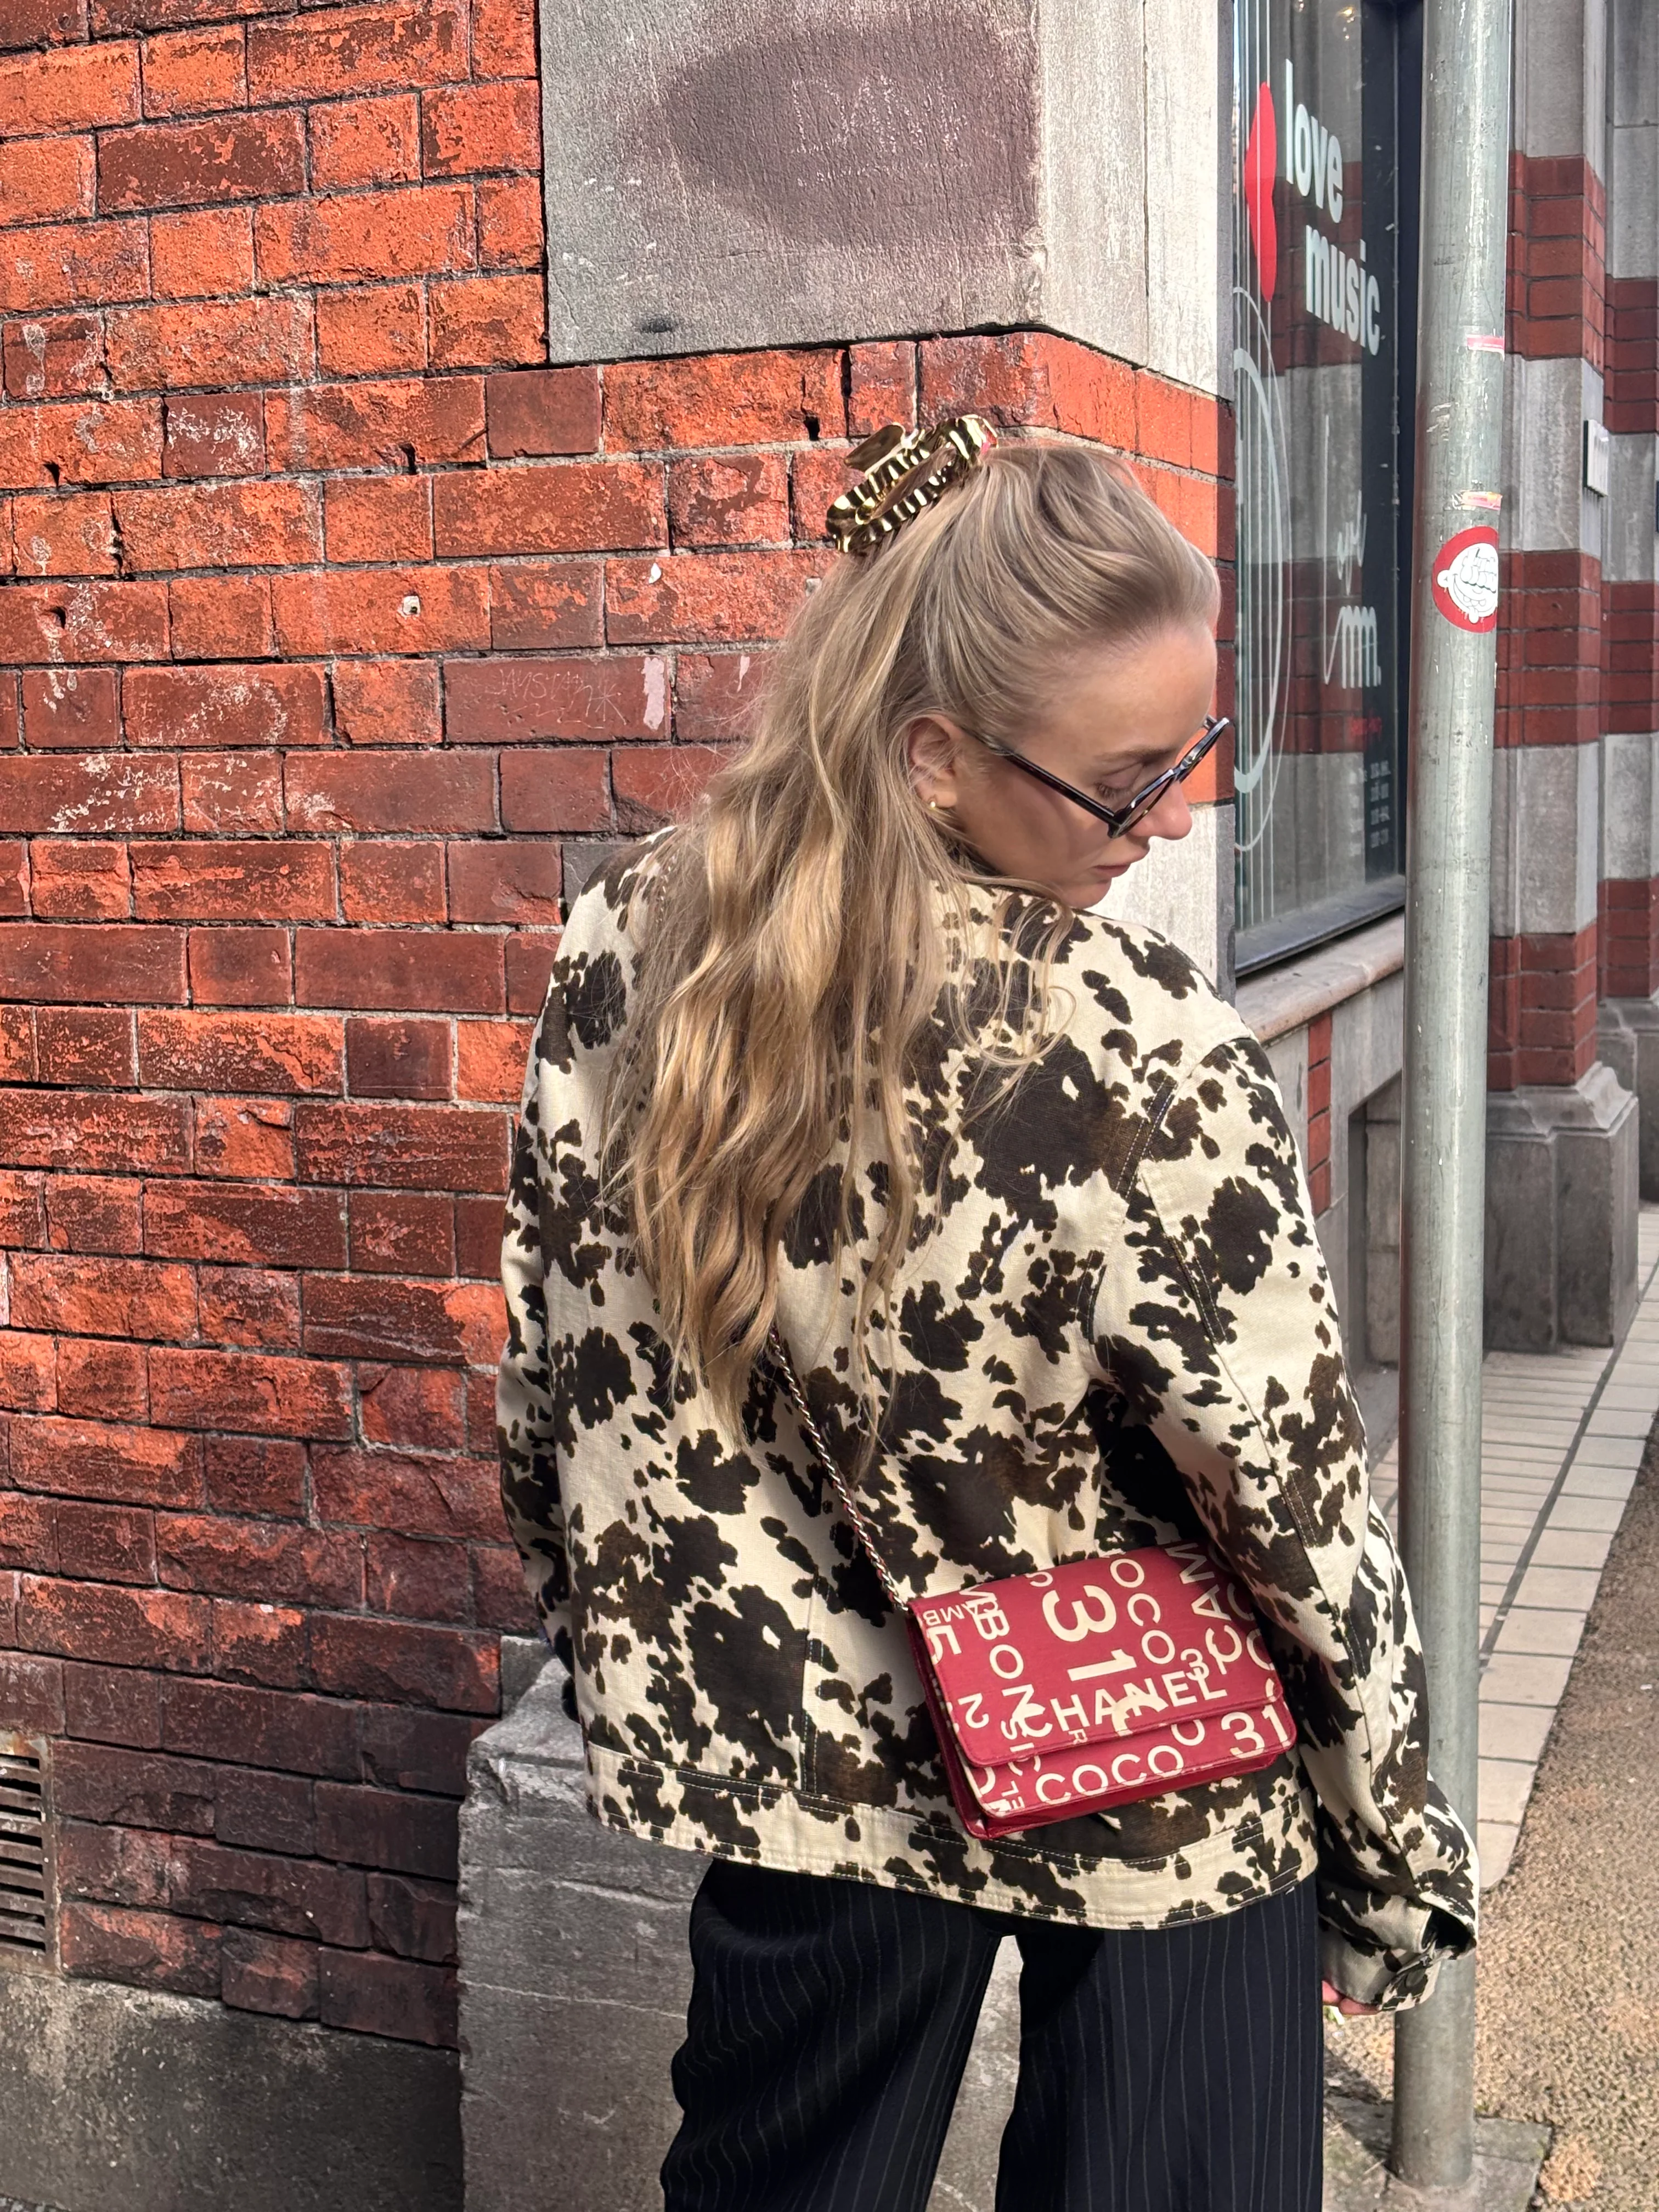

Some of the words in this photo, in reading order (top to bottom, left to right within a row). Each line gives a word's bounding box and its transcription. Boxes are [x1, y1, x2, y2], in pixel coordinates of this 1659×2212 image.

[1285, 58, 1343, 224] love
[1306, 224, 1381, 356] music
[1042, 1584, 1137, 1681] 31
[1017, 1667, 1228, 1738] CHANEL
[1221, 1705, 1291, 1759] 31
[1035, 1745, 1184, 1805] COCO
